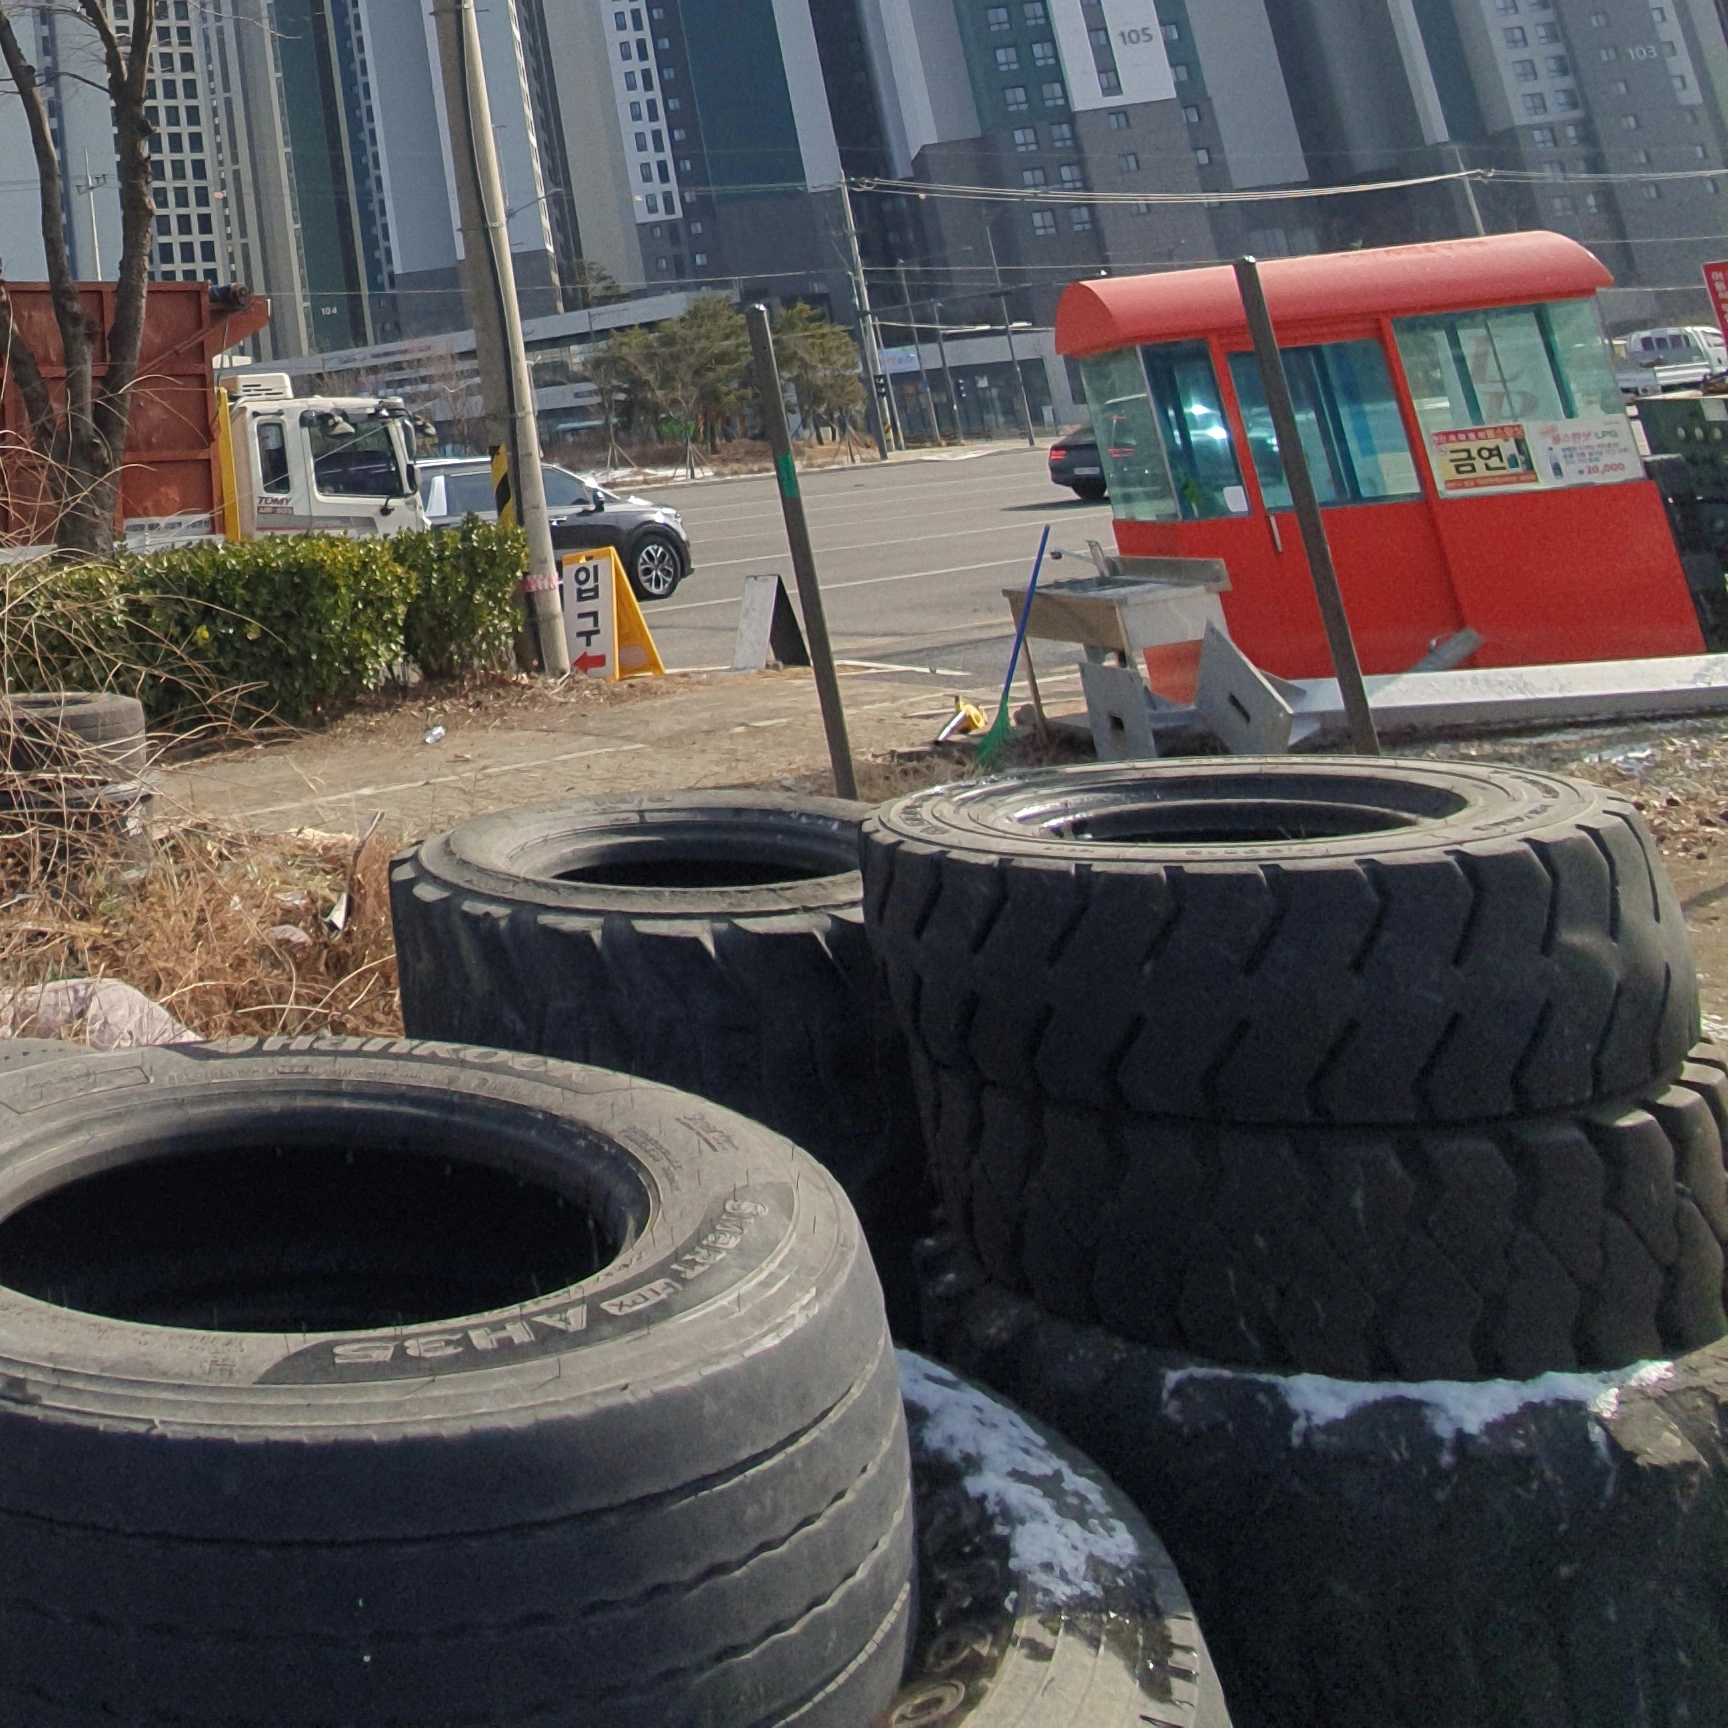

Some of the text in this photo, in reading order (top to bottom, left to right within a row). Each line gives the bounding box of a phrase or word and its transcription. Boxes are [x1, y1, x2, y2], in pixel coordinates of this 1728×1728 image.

[1118, 26, 1154, 46] 105
[1628, 45, 1657, 61] 103
[321, 306, 338, 315] 104
[1449, 444, 1508, 475] 금연
[574, 563, 601, 647] 입구
[333, 1303, 588, 1364] AH35
